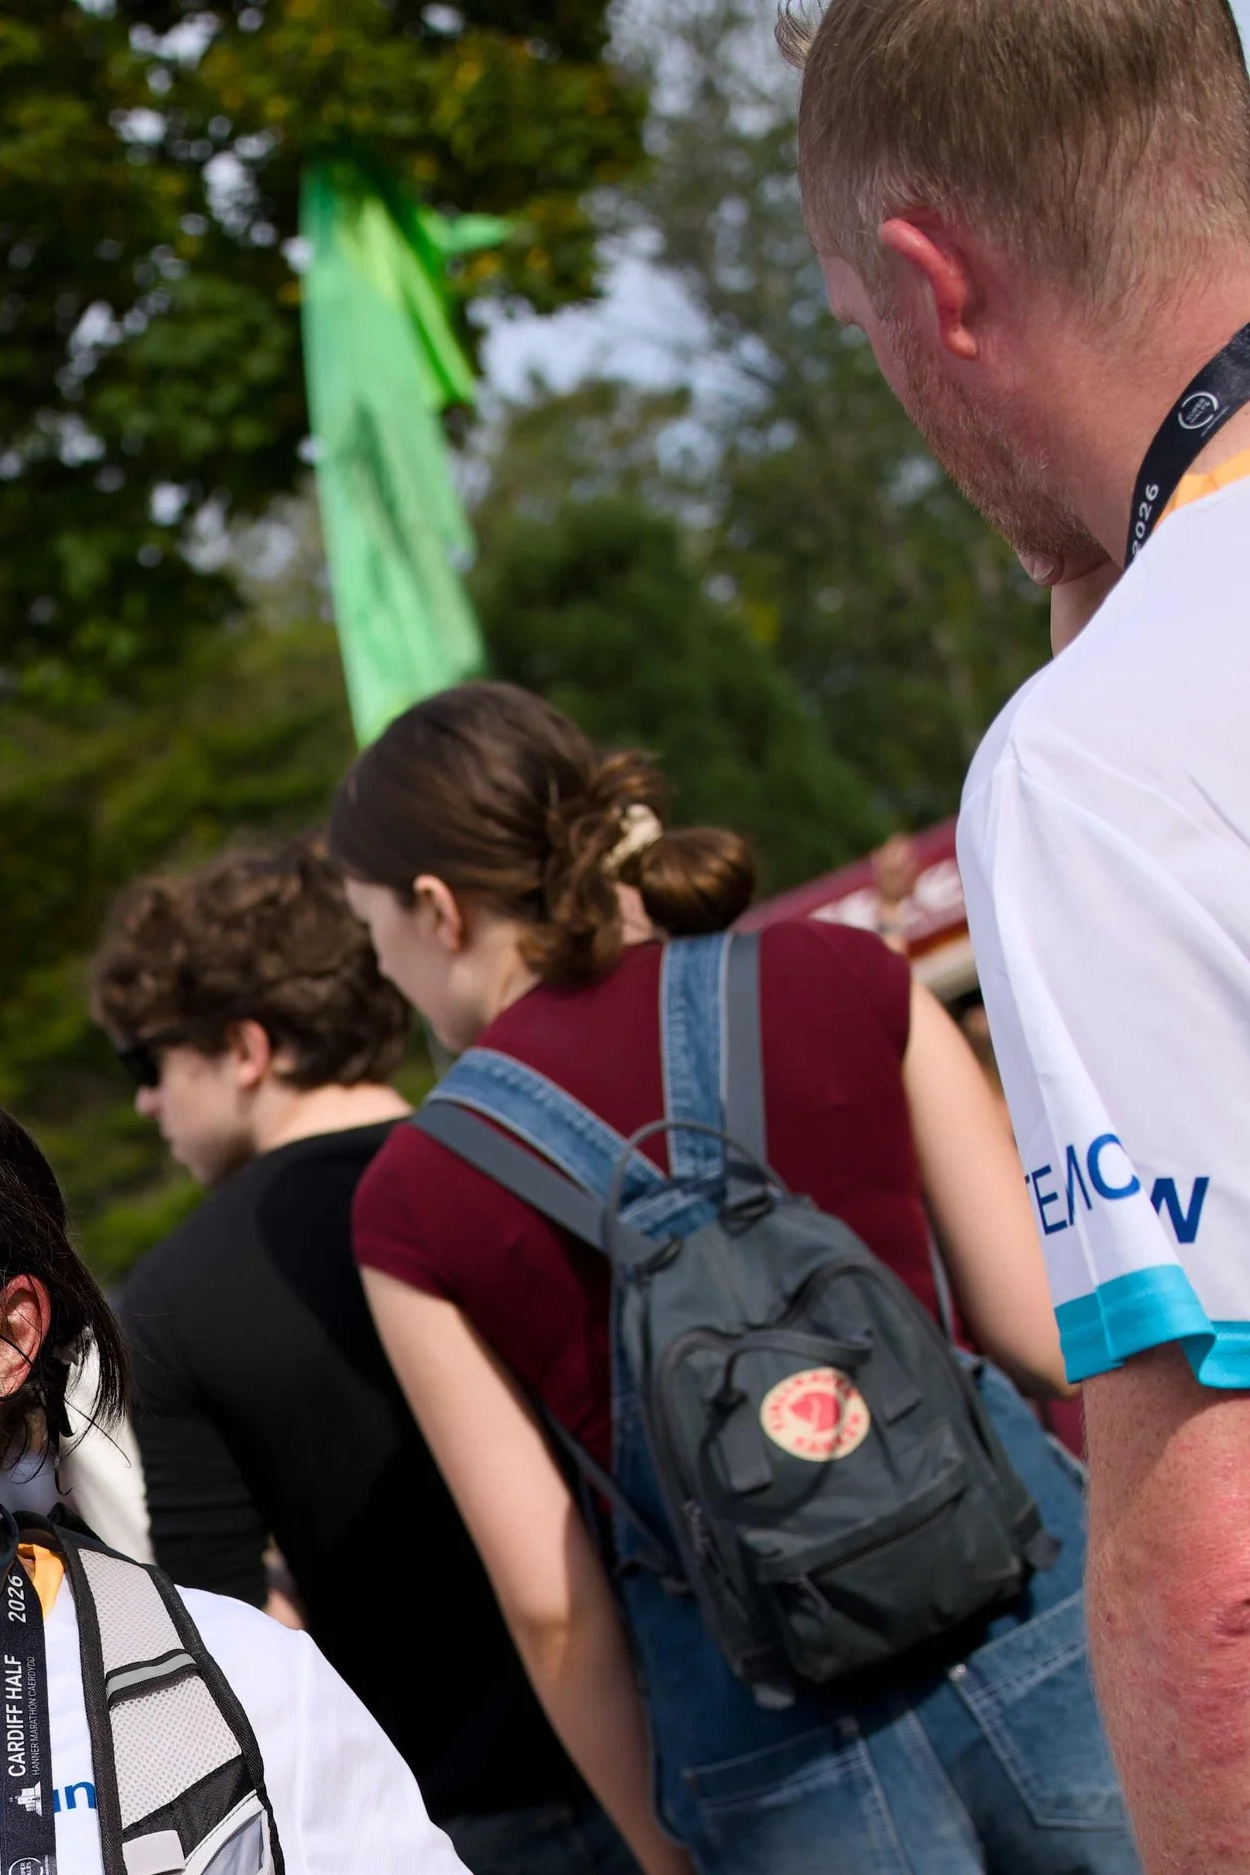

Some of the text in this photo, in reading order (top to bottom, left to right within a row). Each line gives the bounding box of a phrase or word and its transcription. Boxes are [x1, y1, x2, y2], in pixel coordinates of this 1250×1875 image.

[7, 1575, 27, 1623] 2026
[4, 1654, 26, 1777] CARDIFF HALF
[27, 1656, 41, 1776] HANNER MARATHON CAERDYDD
